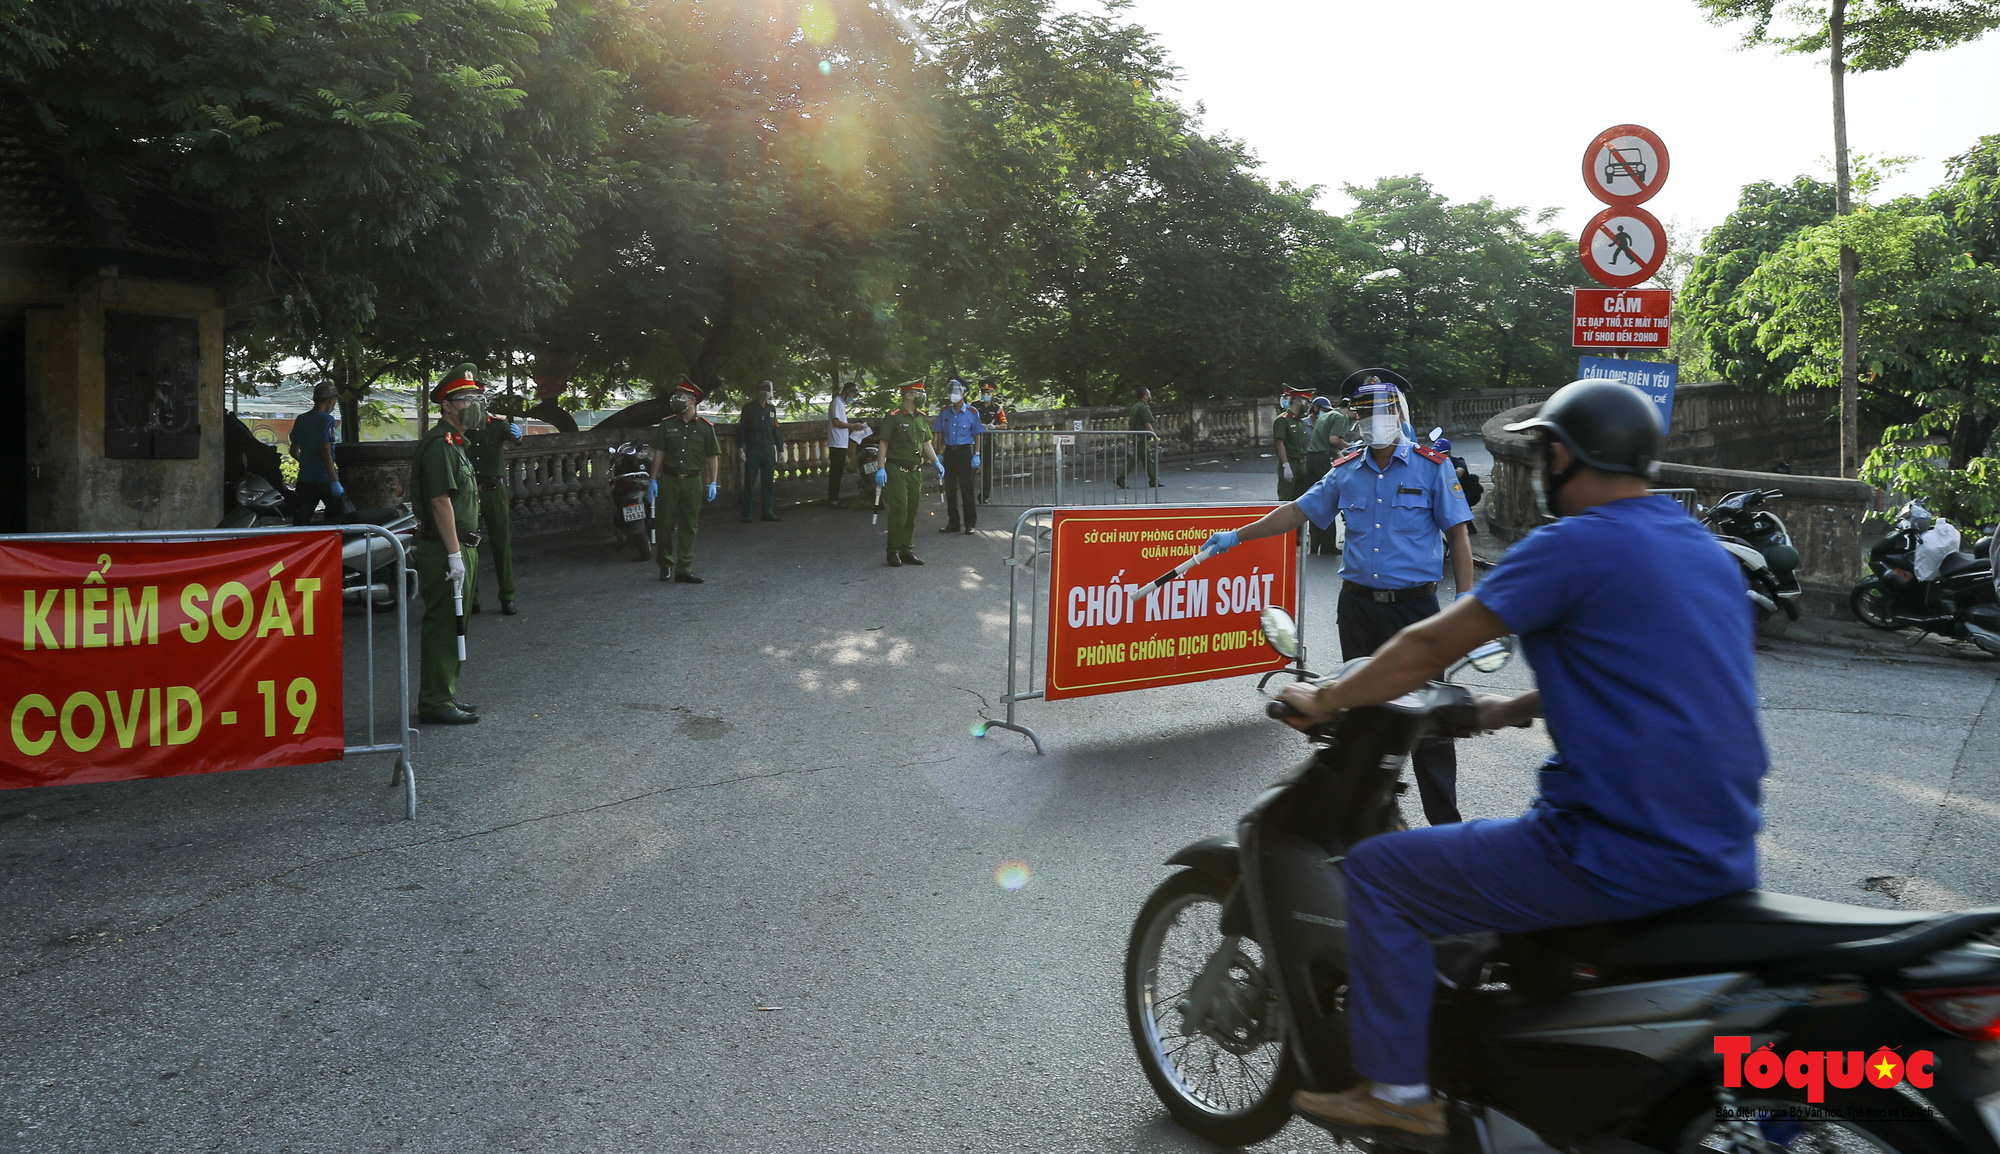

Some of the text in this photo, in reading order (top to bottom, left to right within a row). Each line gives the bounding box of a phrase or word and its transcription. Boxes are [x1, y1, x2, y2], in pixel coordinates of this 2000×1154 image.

[1604, 291, 1642, 313] CẤM
[1576, 317, 1587, 327] XE
[1588, 317, 1604, 329] ĐẠP
[1623, 318, 1634, 327] XE
[1635, 316, 1651, 328] MÁY
[1595, 332, 1615, 342] 5H00
[1616, 329, 1633, 342] ĐẾN
[1633, 332, 1659, 343] 20H00
[1627, 370, 1650, 387] BIÊN
[1652, 370, 1670, 388] YẾU
[1084, 528, 1099, 544] SỞ
[1100, 528, 1118, 543] CHỈ
[1119, 530, 1140, 543] HUY
[1141, 528, 1175, 542] PHÒNG
[1176, 525, 1207, 541] CHỐNG
[1141, 544, 1168, 560] QUẬN
[1170, 543, 1197, 558] HOÀN
[22, 553, 321, 651] KIỂM SOÁT
[1068, 569, 1140, 628] CHỐT
[1215, 566, 1275, 615] SOÁT
[1076, 629, 1266, 667] PHÒNG CHỐNG DỊCH COVID-19
[10, 685, 203, 757] COVID
[257, 676, 318, 738] 19
